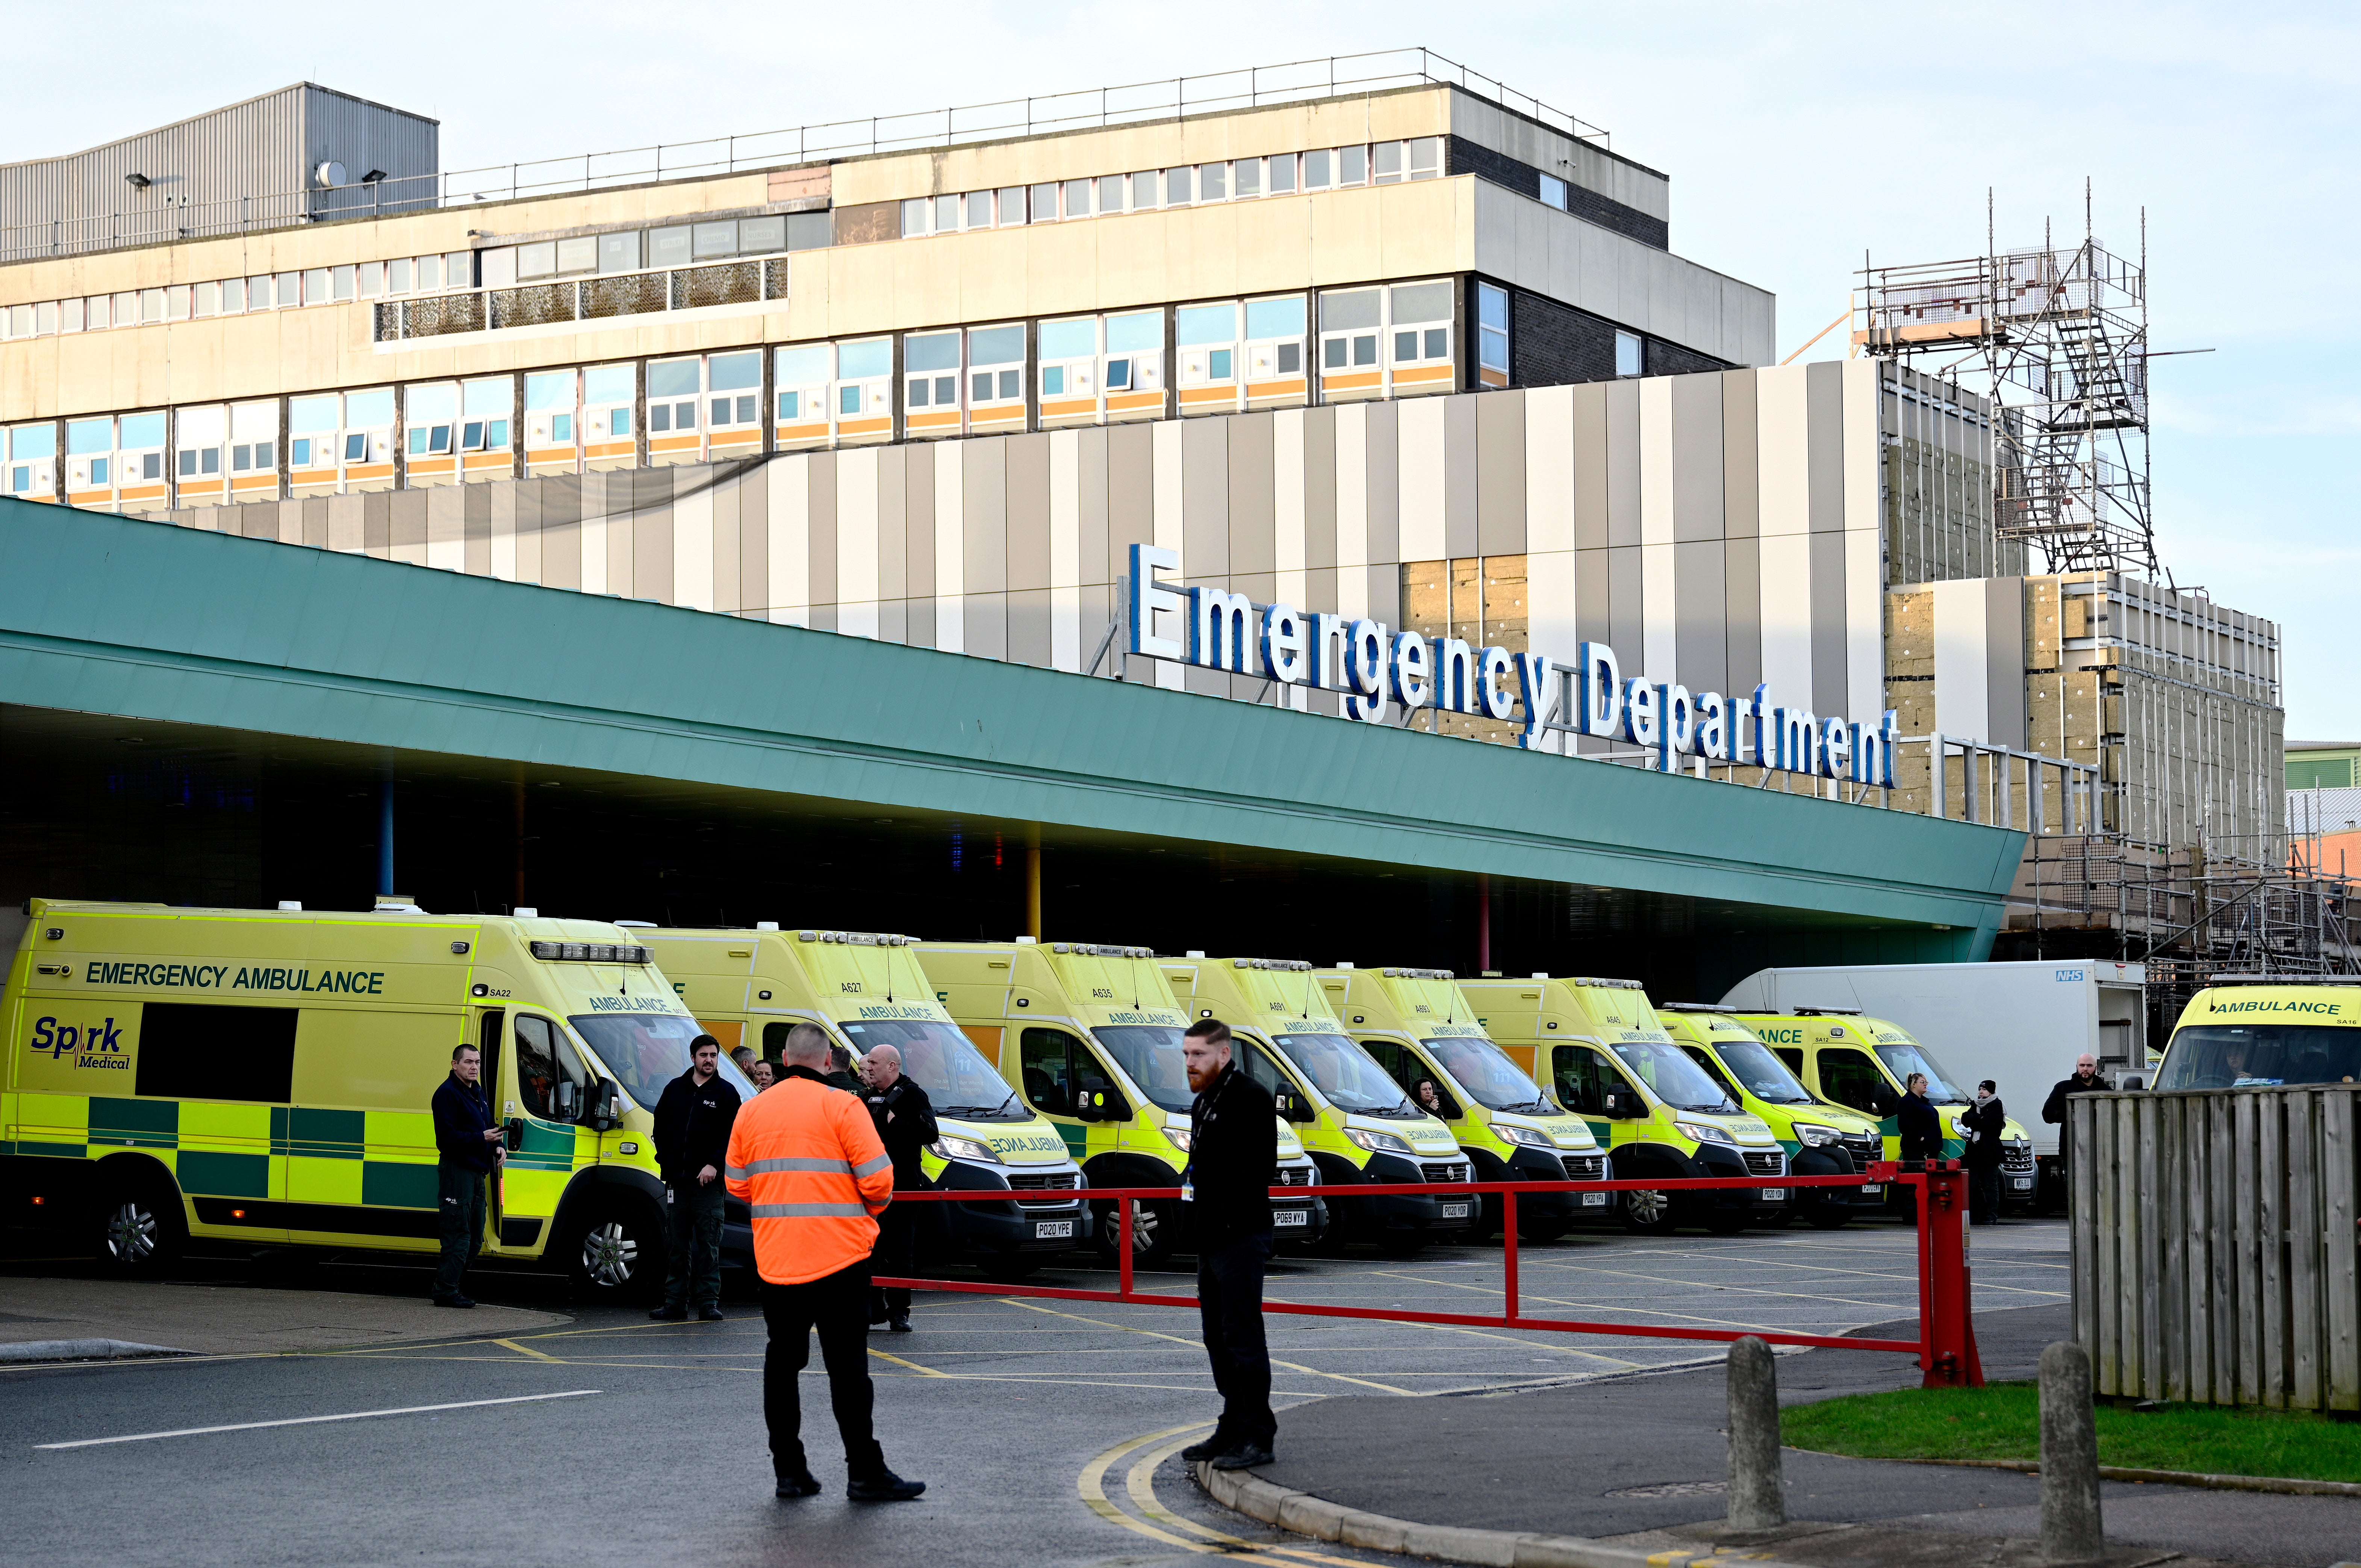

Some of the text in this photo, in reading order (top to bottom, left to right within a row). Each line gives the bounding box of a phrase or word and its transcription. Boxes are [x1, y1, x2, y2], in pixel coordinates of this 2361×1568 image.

[703, 235, 725, 243] CHEMO
[1128, 543, 1902, 789] Emergency Department
[86, 962, 384, 994] EMERGENCY AMBULANCE
[2057, 970, 2082, 981] NHS
[489, 988, 511, 998] SA22
[841, 982, 862, 993] A627
[1093, 988, 1112, 998] A635
[589, 997, 672, 1013] AMBULANCE
[1270, 1002, 1286, 1011] A691
[1415, 1005, 1430, 1013] A693
[2214, 1001, 2341, 1015] AMBULANCE
[859, 1006, 937, 1020] AMBULANCE
[1109, 1013, 1179, 1026] AMBULANCE
[1283, 1022, 1339, 1033] AMBULANCE
[1431, 1026, 1482, 1037] AMBULANCE
[1620, 1032, 1668, 1043] AMBULANCE
[78, 1056, 130, 1070] Medical
[1493, 1072, 1510, 1082] 111
[1585, 1194, 1595, 1204] PO20
[1764, 1190, 1775, 1198] PO20
[1445, 1205, 1466, 1215] PO20 YOR
[1276, 1212, 1305, 1223] PO69 WYA
[1039, 1223, 1070, 1235] PO20 YPE
